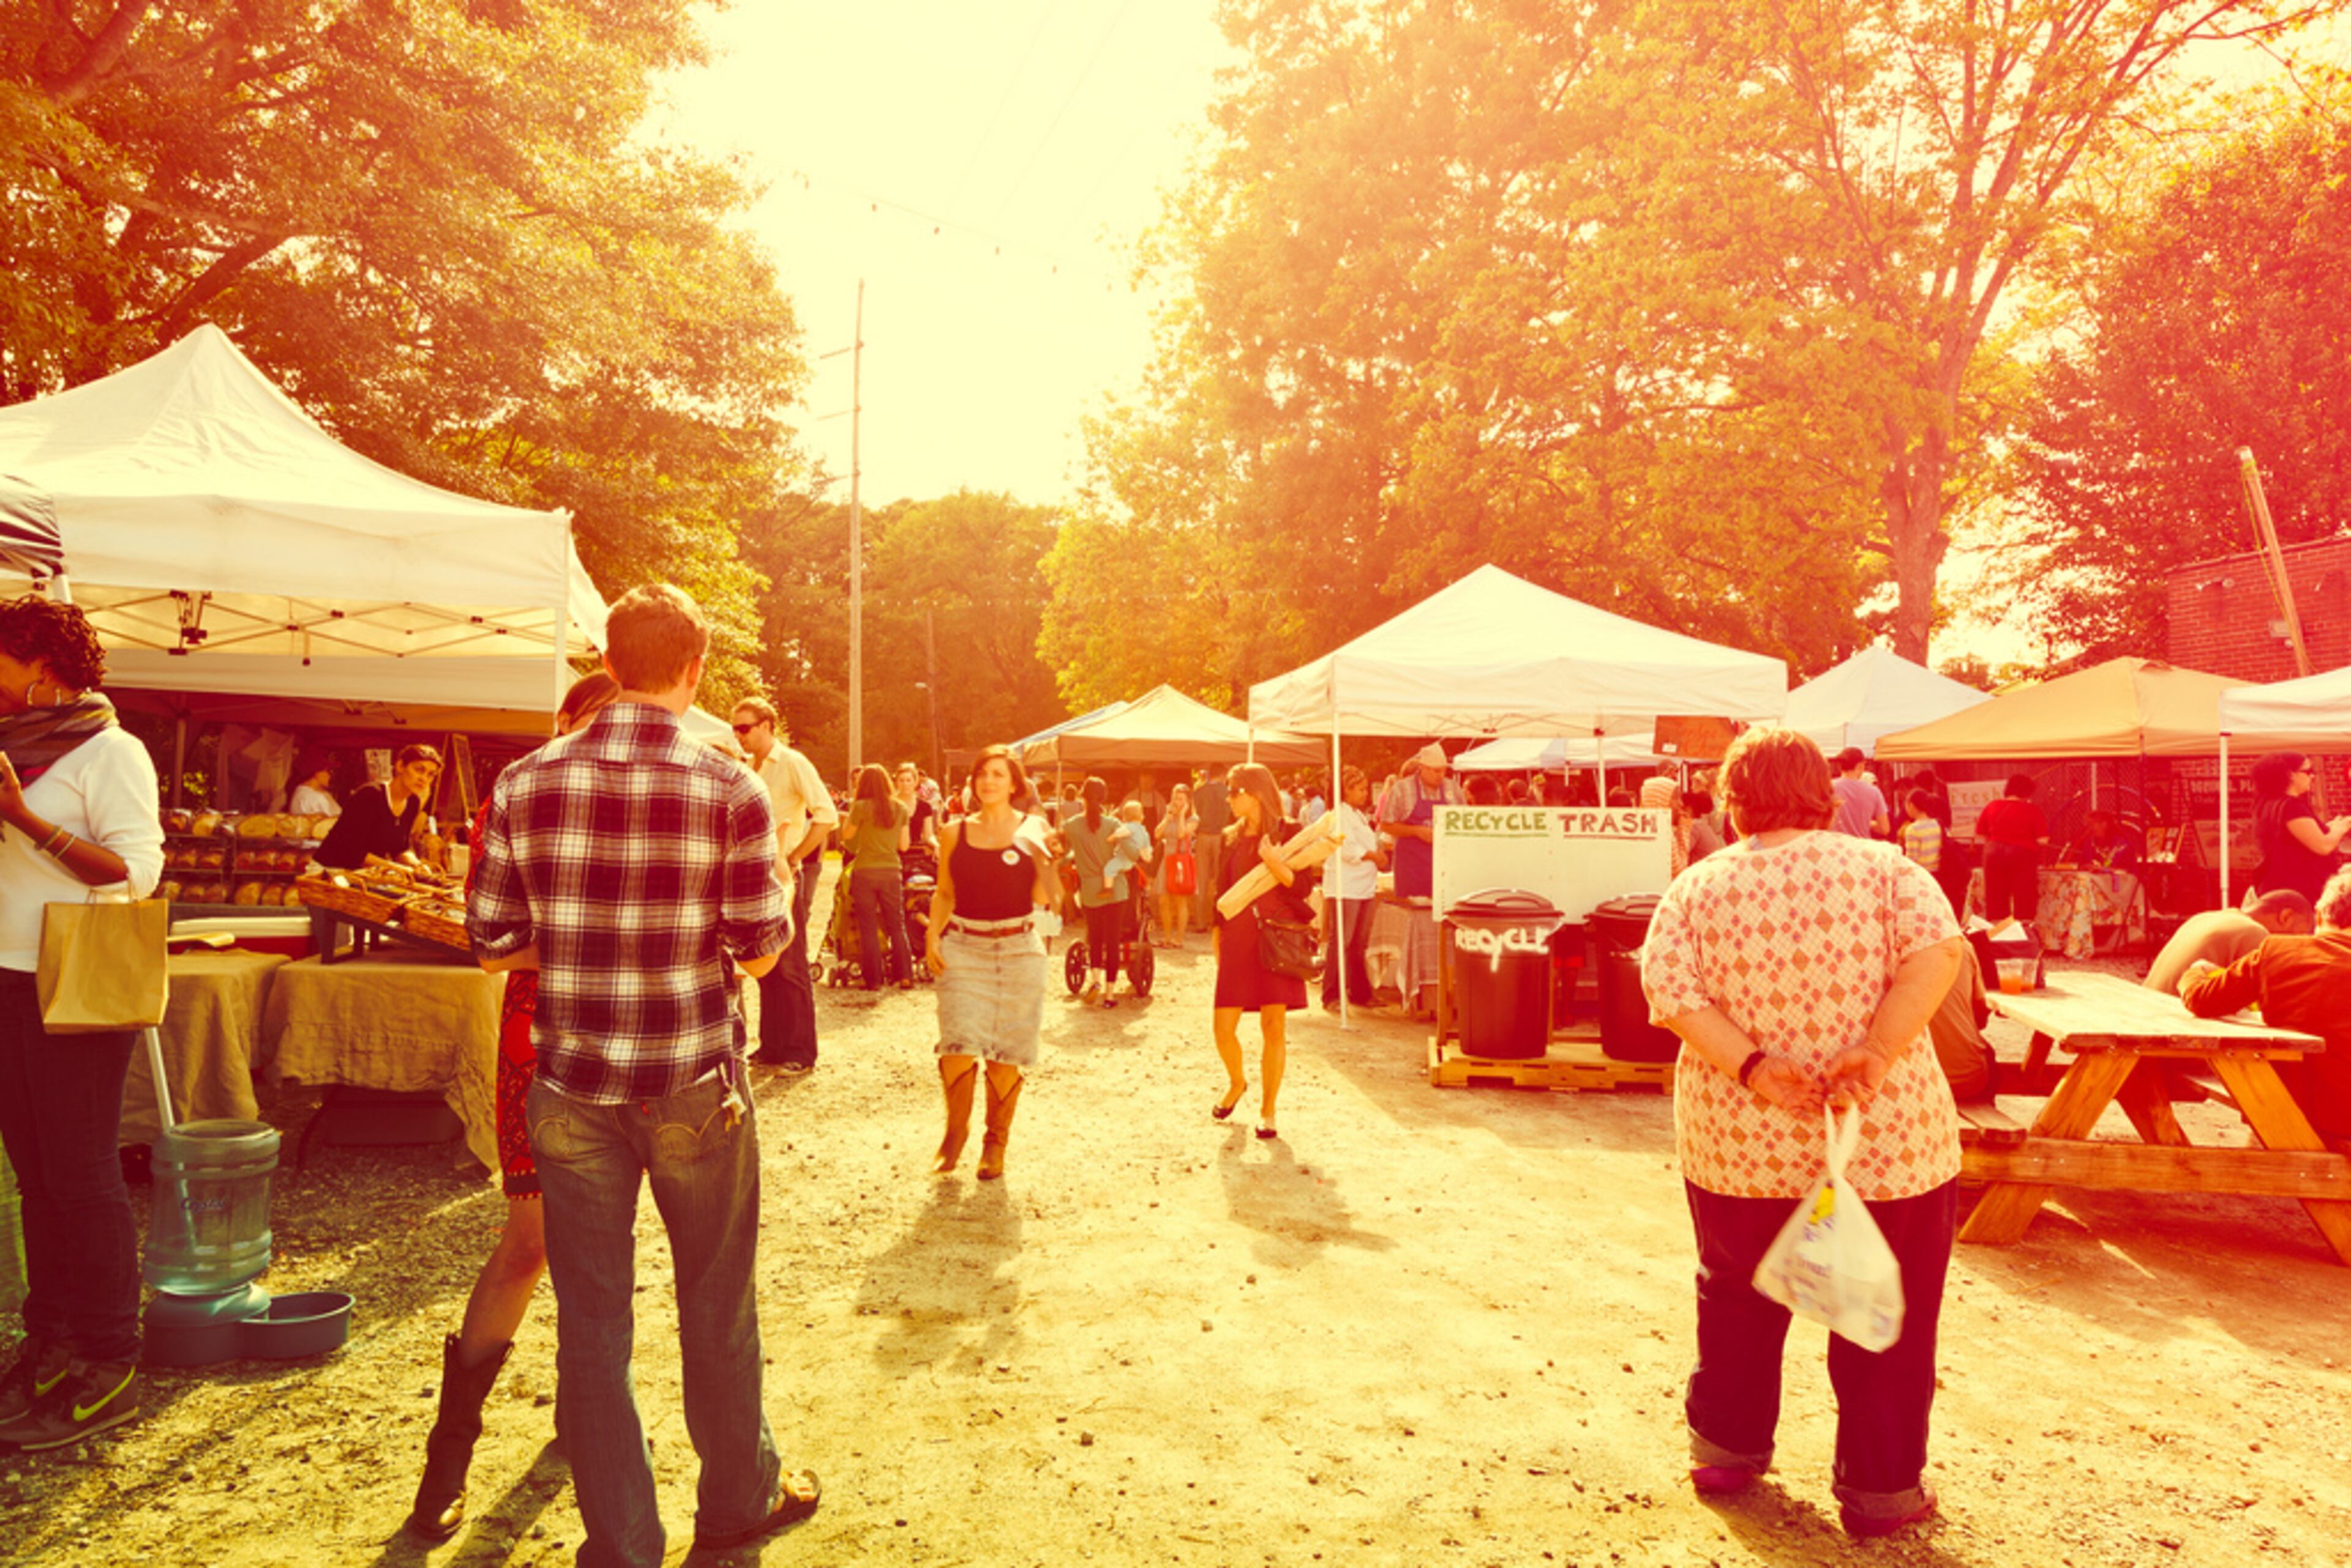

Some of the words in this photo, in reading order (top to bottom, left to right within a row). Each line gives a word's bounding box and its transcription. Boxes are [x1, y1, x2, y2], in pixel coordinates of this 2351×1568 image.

[1445, 811, 1547, 830] RECYCLE
[1558, 813, 1658, 833] TRASH
[1455, 928, 1549, 972] RECYCLE
